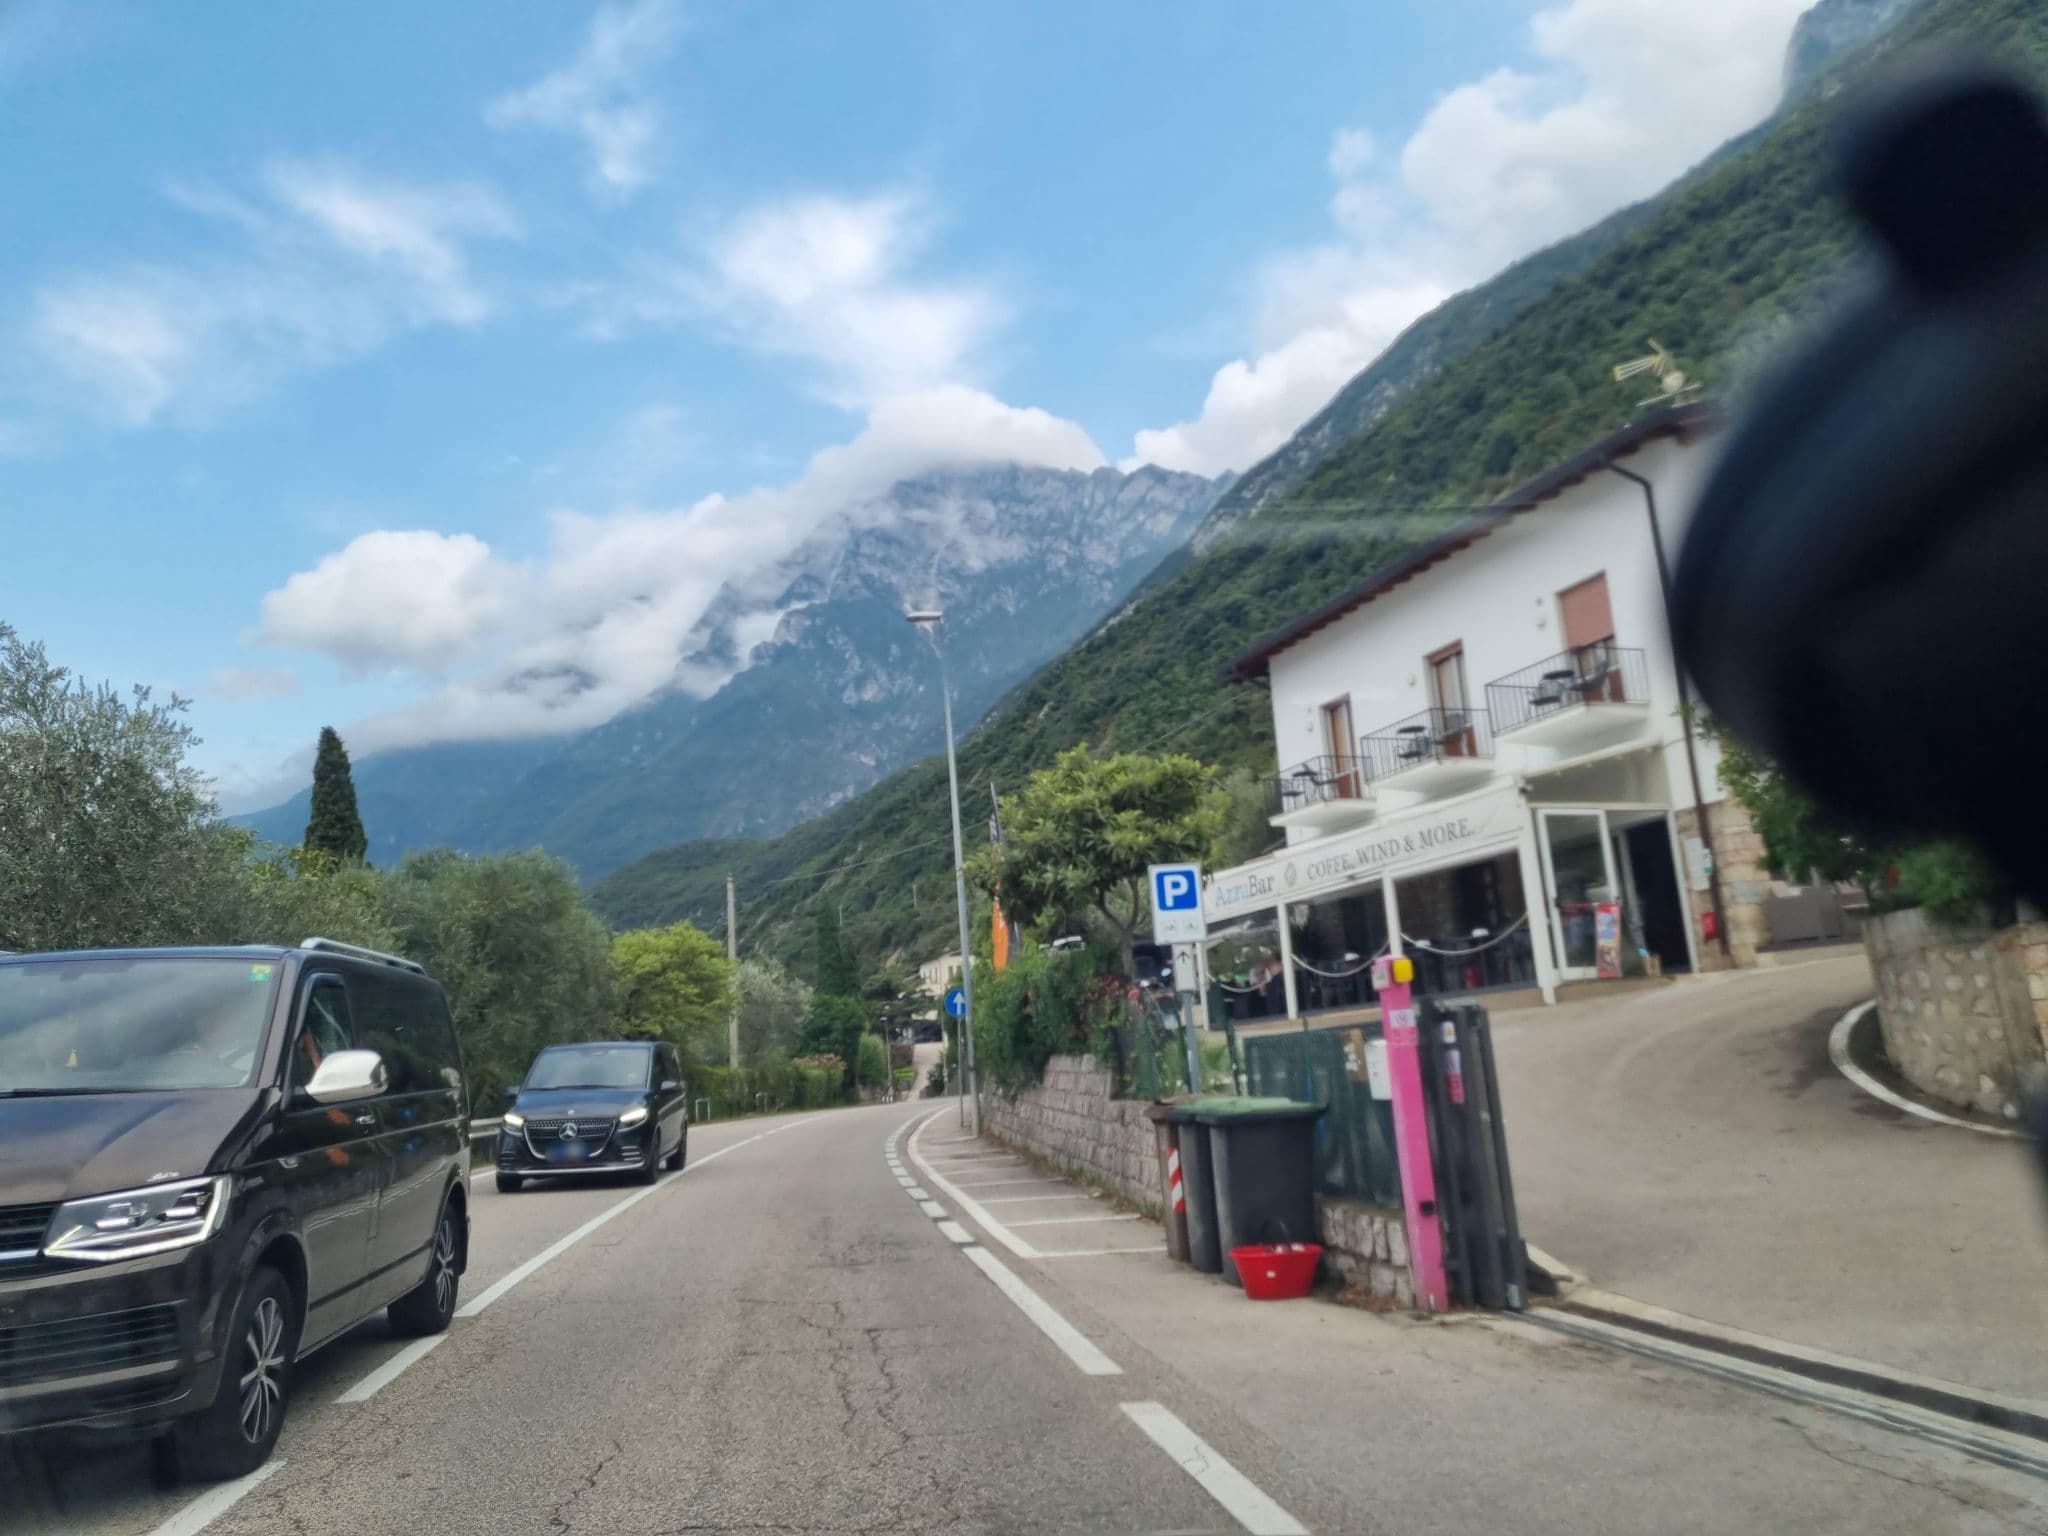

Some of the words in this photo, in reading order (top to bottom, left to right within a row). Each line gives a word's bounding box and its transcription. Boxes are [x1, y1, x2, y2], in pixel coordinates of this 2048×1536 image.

[1356, 838, 1401, 865] WIND
[1404, 834, 1416, 853] &
[1163, 873, 1189, 908] P
